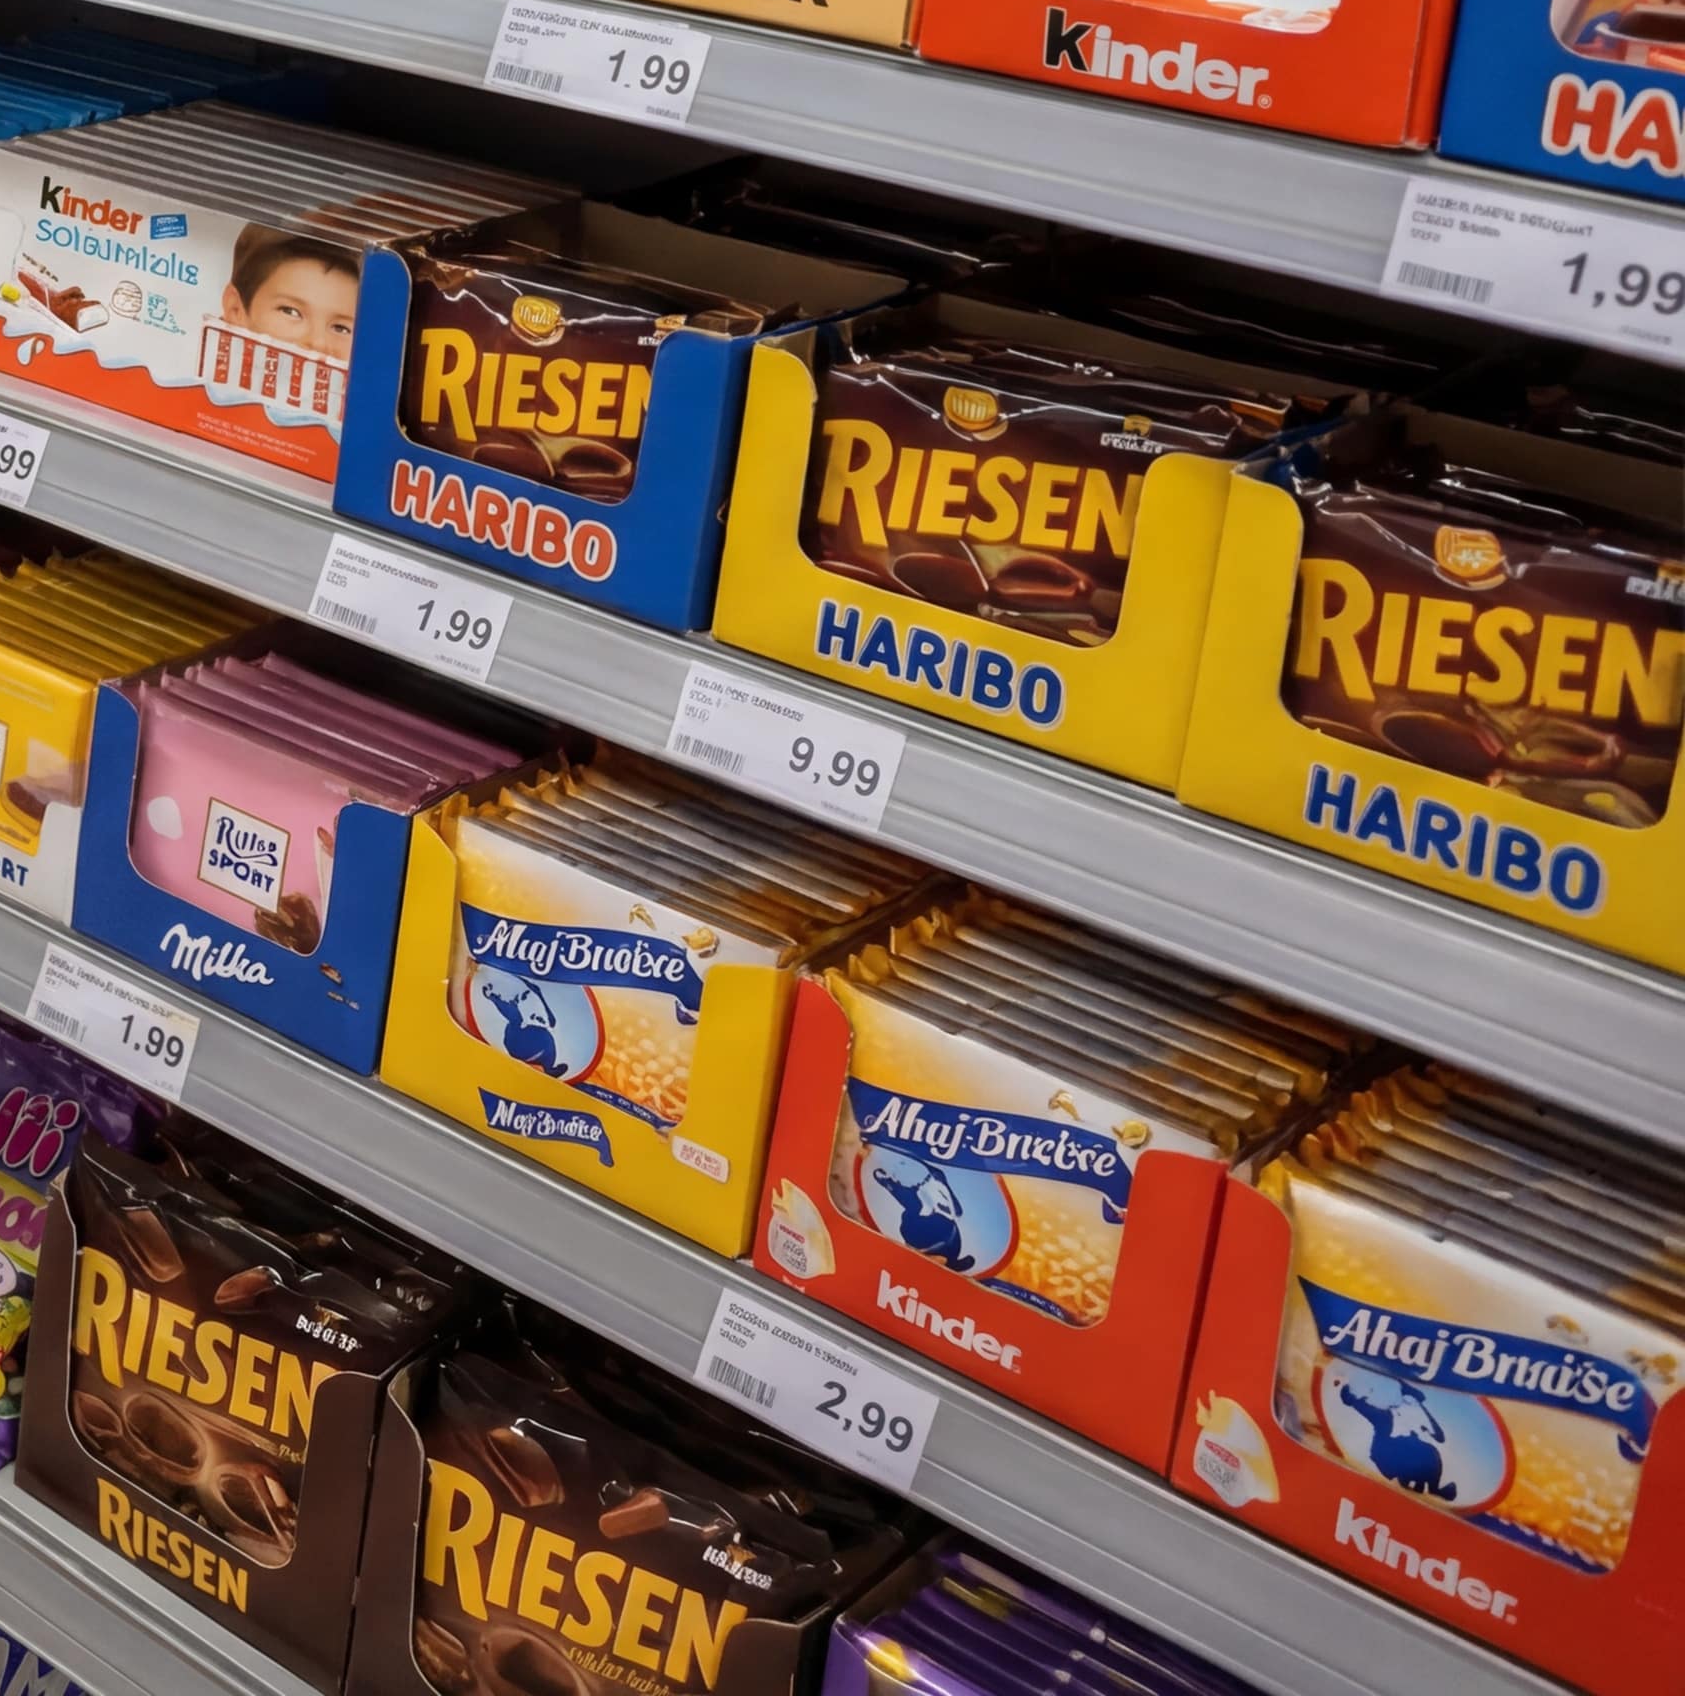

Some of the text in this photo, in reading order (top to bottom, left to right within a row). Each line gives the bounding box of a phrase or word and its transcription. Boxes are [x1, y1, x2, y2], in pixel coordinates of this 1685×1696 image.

[389, 459, 617, 583] HARIBO
[822, 417, 1148, 563] RIESEN
[415, 598, 495, 652] 1,99
[814, 598, 1066, 731] HARIBO
[1293, 555, 1685, 730] RIESEN
[786, 735, 882, 800] 9,99
[1303, 760, 1605, 919] HARIBO
[158, 922, 276, 988] Milka
[119, 1013, 186, 1069] 1.99
[73, 1245, 337, 1446] RIESEN
[812, 1379, 917, 1457] 2,99
[96, 1477, 250, 1613] RIESEN
[422, 1457, 749, 1692] RIESEN
